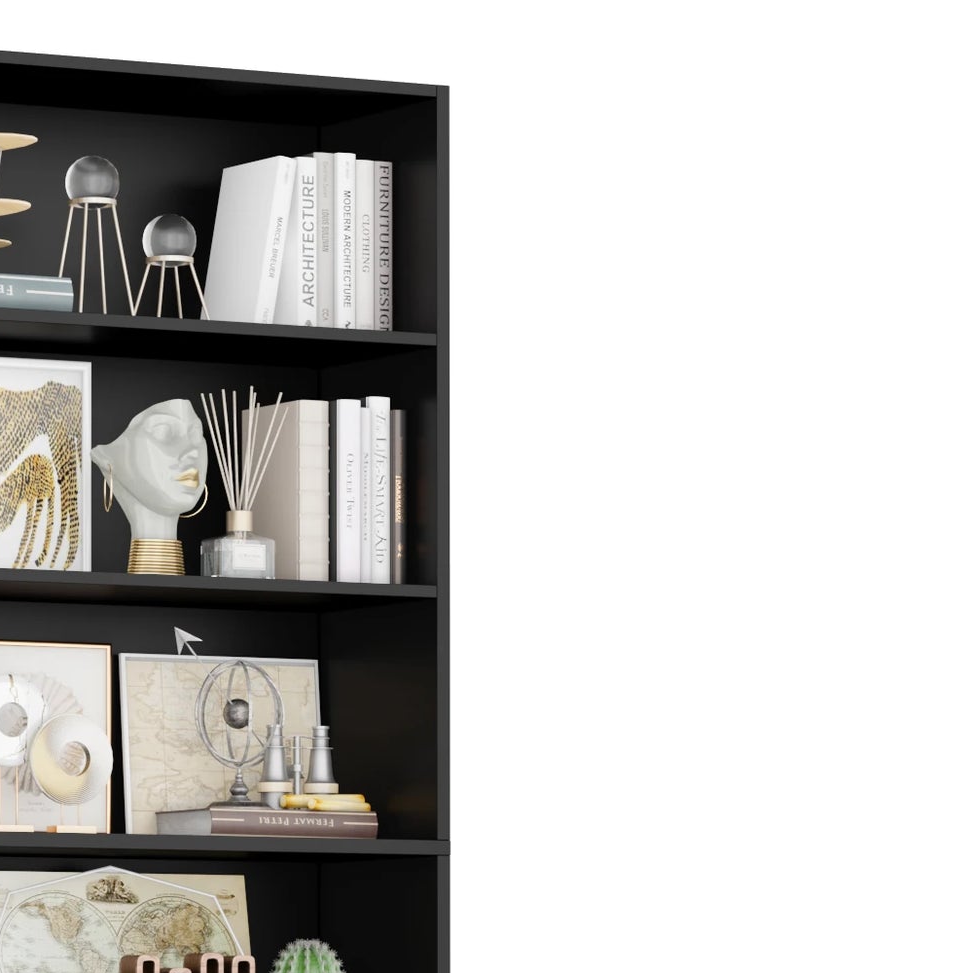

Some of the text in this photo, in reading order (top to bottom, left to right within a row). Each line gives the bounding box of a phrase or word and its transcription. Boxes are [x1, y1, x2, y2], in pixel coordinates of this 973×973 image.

[269, 217, 283, 279] MARCEL BREUER
[302, 175, 315, 307] ARCHITECTURE
[343, 190, 351, 308] MODERN ARCHITECTURE
[362, 214, 370, 273] CLOTHING
[379, 165, 389, 268] FURNITURE
[258, 815, 334, 828] FERMAT PETRI
